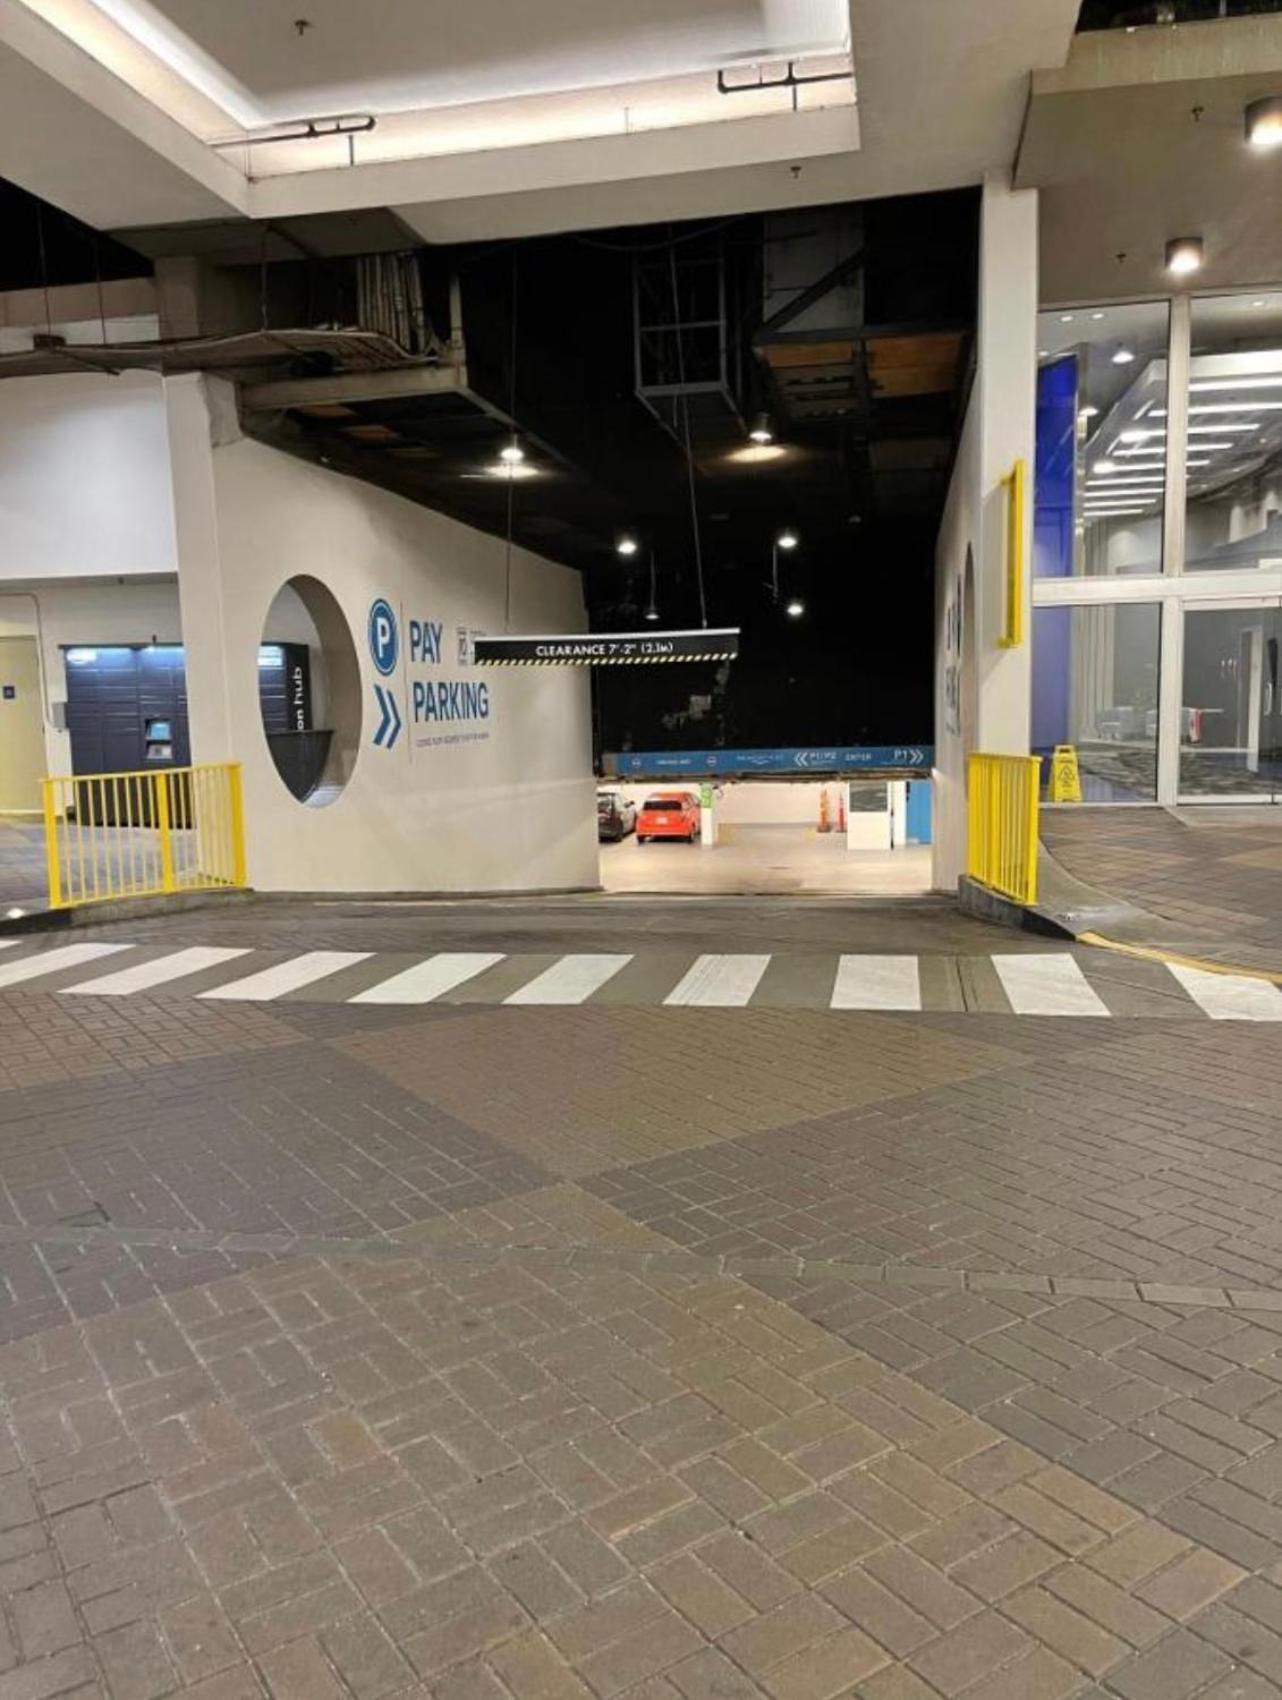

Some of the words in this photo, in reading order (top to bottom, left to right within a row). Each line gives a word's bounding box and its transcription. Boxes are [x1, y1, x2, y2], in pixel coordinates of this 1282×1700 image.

[376, 617, 391, 658] P
[409, 620, 443, 664] PAY
[535, 643, 606, 657] CLEARANCE
[292, 665, 304, 705] hub
[412, 681, 489, 723] PARKING
